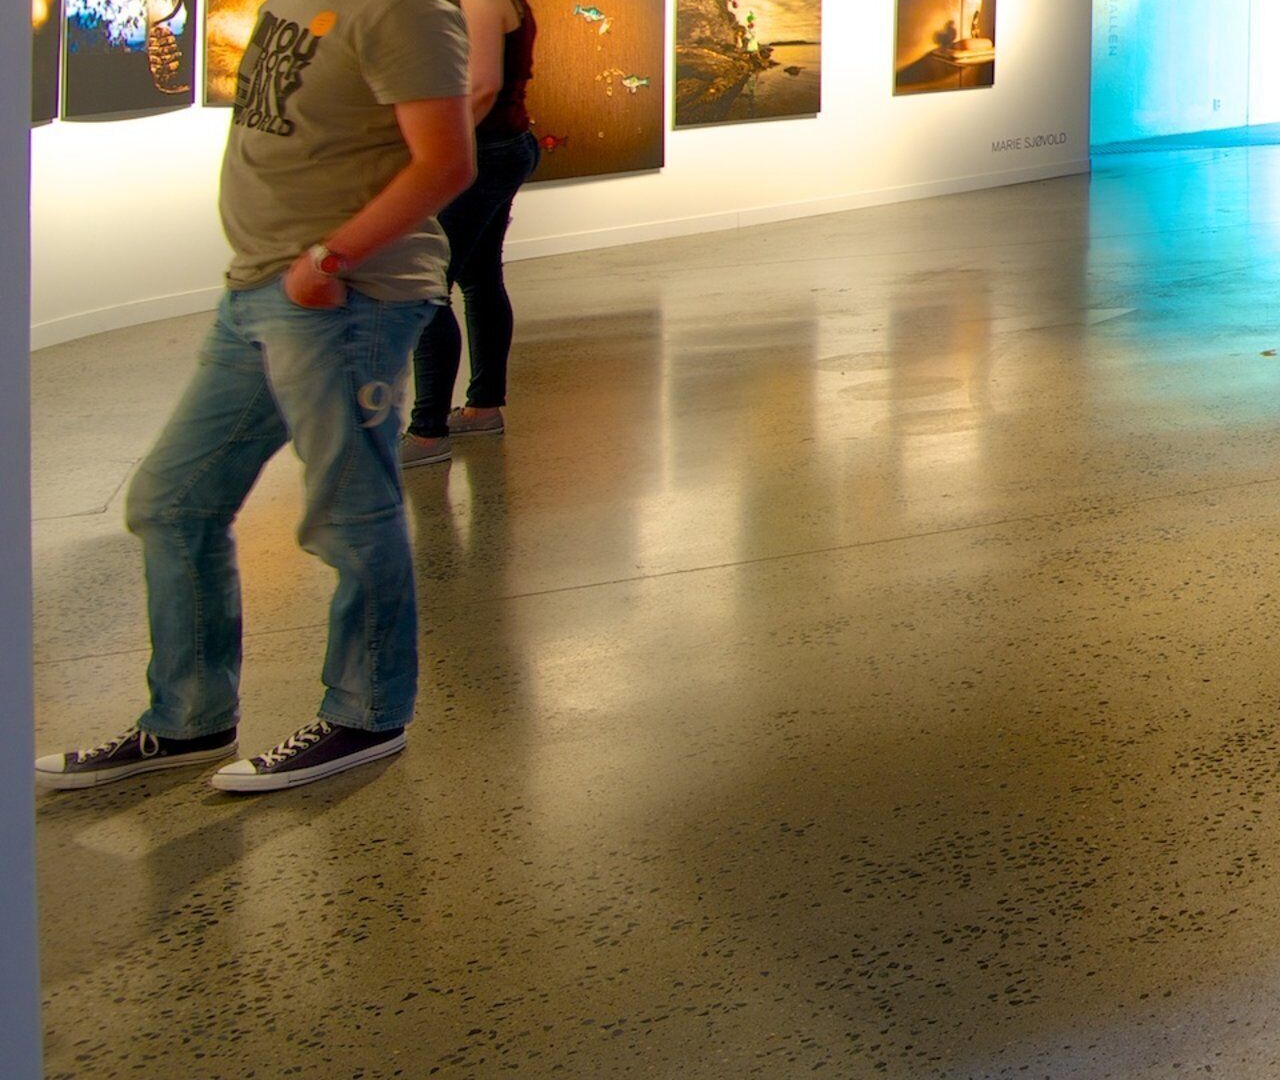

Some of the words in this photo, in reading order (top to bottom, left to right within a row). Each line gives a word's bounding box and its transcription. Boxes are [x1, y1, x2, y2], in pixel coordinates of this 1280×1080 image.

[263, 15, 322, 61] YOU
[991, 137, 1022, 153] MARIE
[1023, 132, 1067, 149] SJØVOLD
